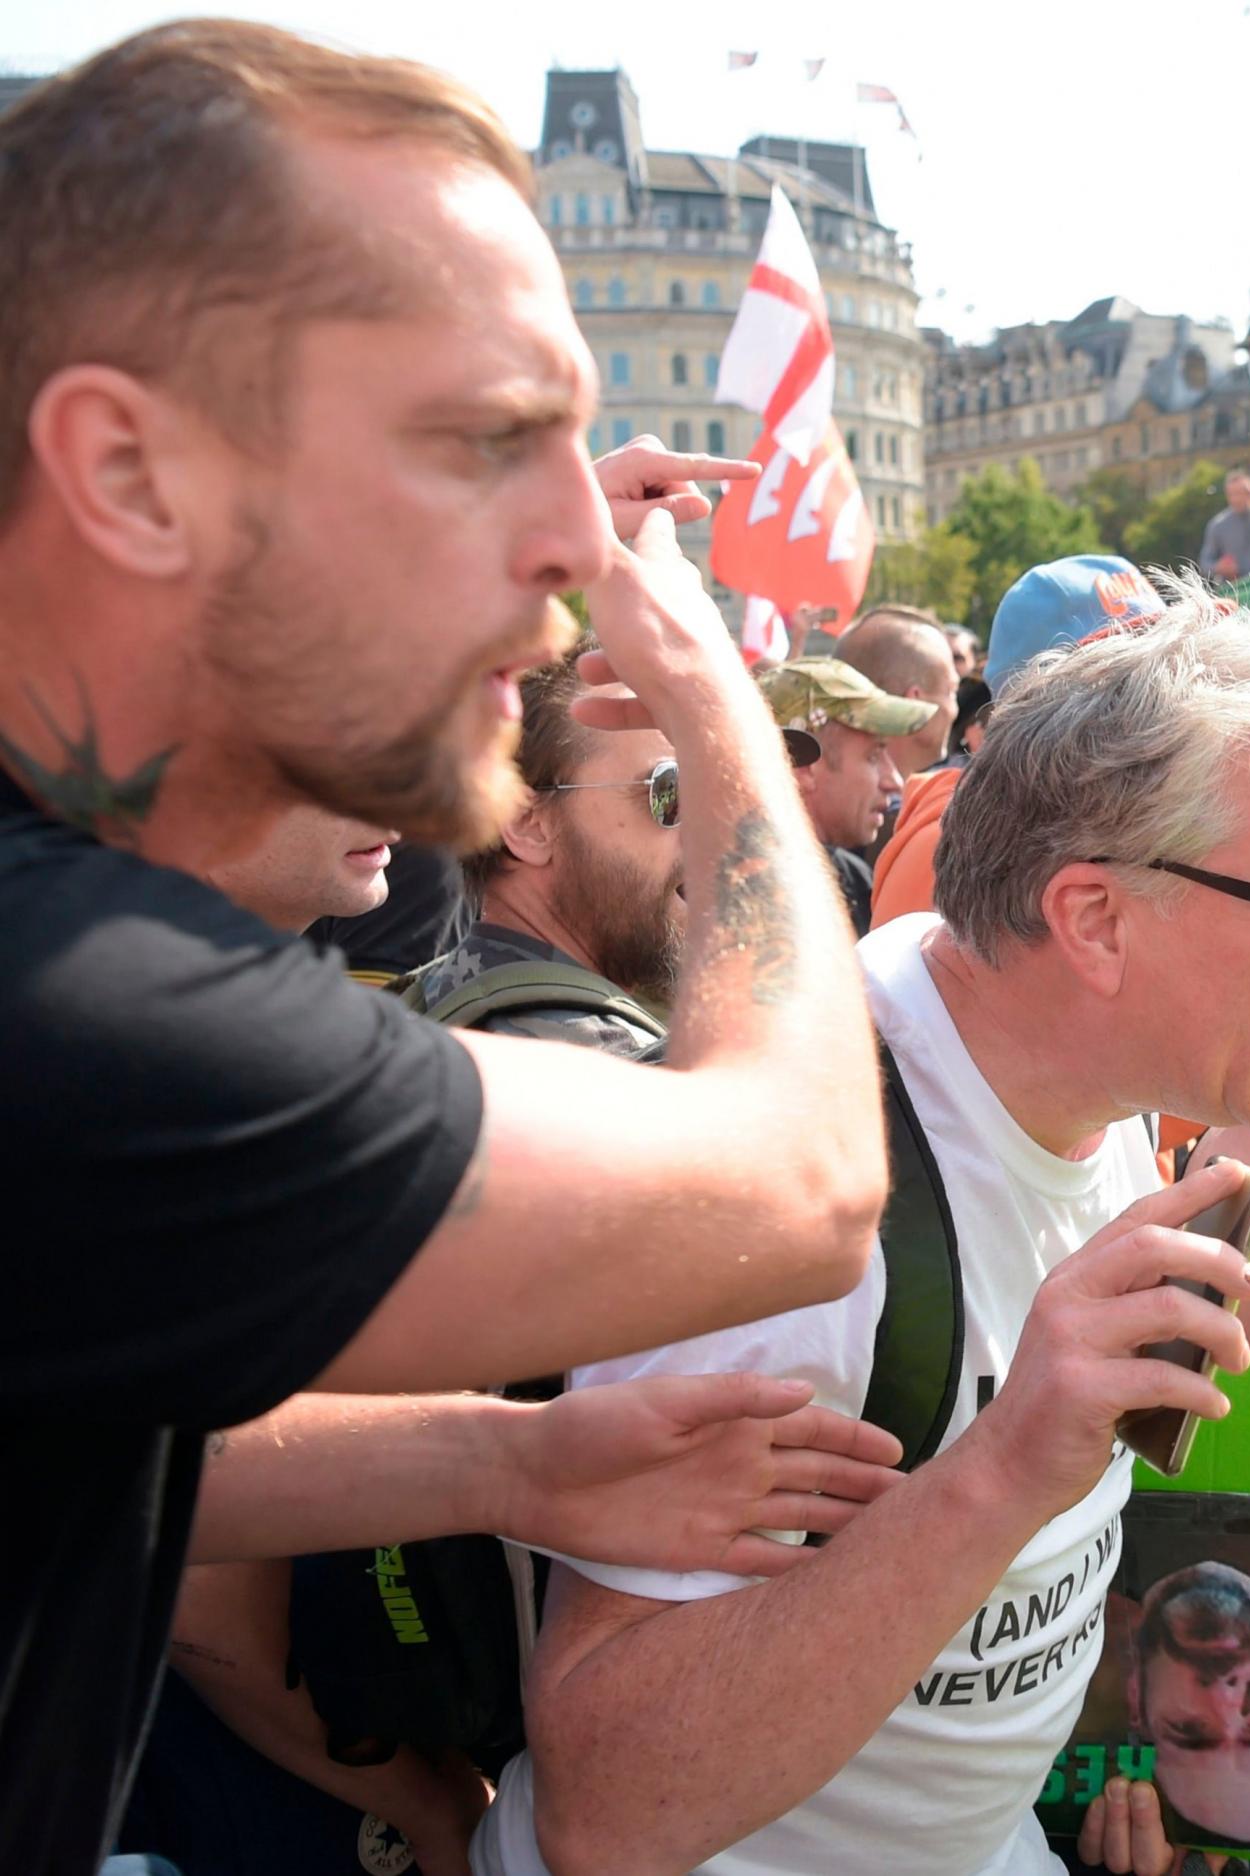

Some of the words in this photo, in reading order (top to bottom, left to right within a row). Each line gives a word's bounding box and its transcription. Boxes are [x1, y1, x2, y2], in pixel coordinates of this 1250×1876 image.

[375, 1546, 430, 1643] NOFE
[970, 1572, 1075, 1661] (AND
[1079, 1553, 1089, 1595] I
[1096, 1513, 1118, 1574] W
[914, 1636, 1069, 1706] NEVER
